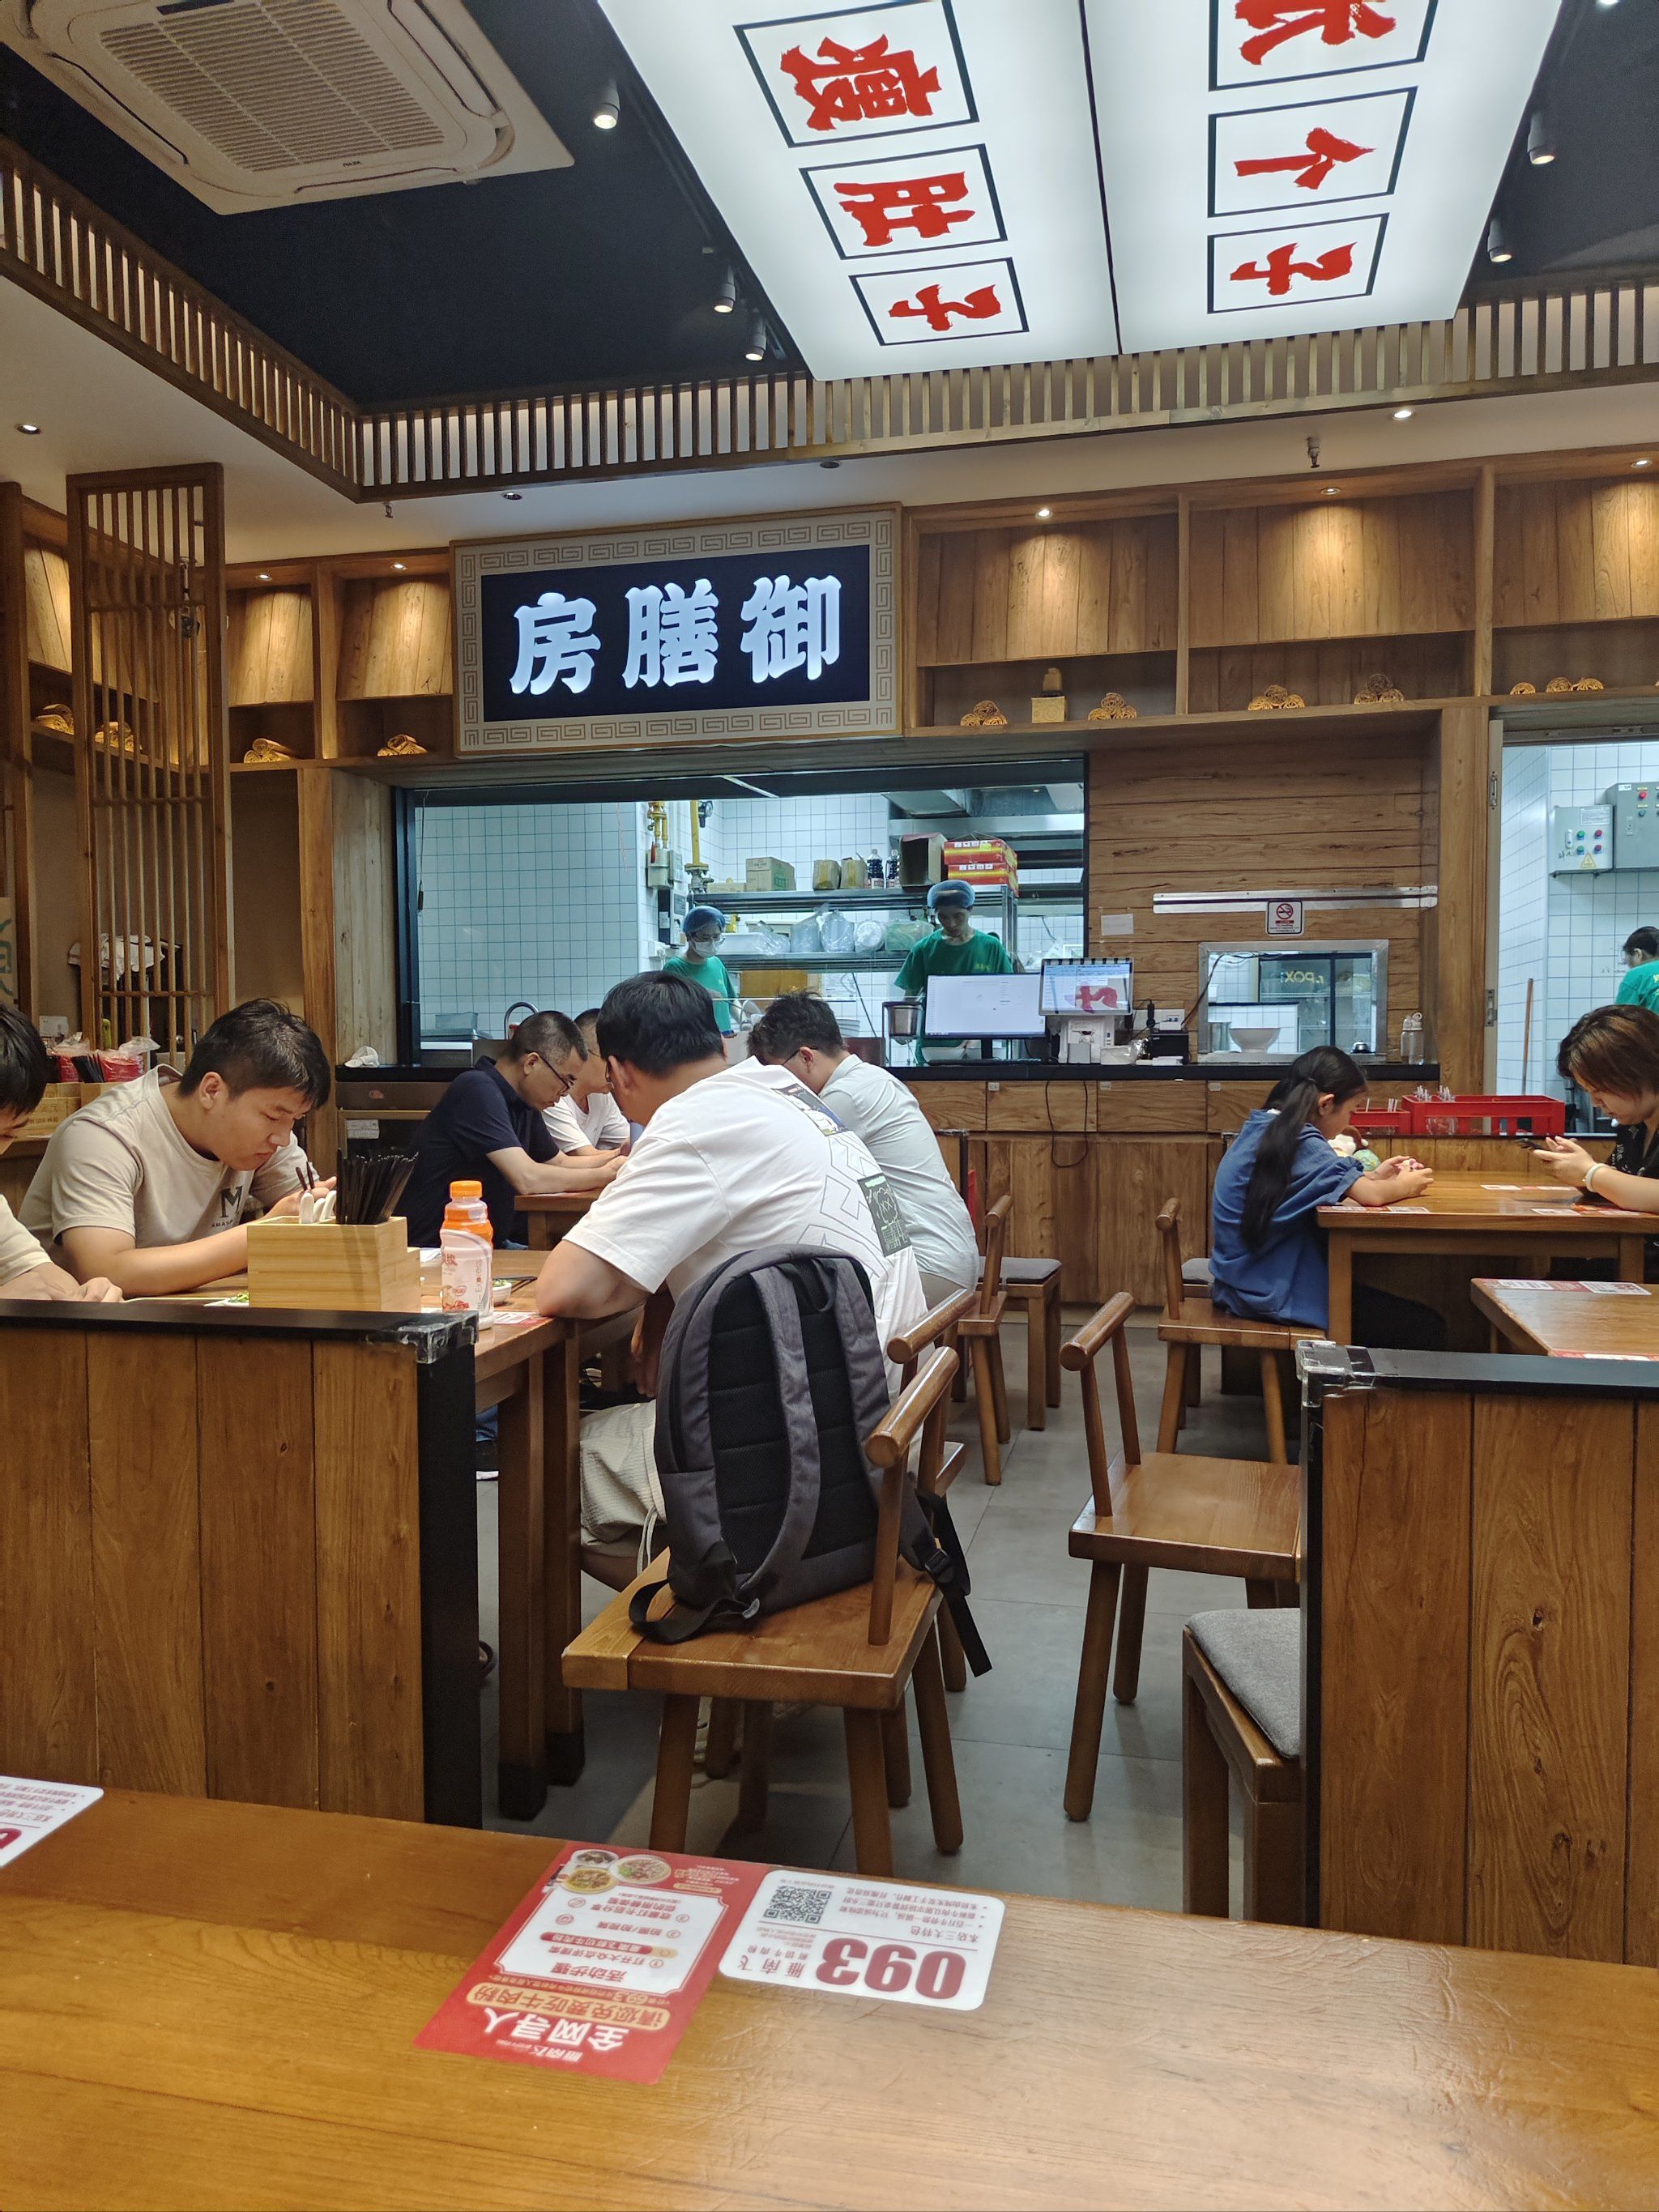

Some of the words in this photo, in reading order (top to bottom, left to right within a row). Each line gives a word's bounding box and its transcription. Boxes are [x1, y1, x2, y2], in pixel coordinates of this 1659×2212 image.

[779, 32, 1003, 333] 瘦肚子
[910, 1924, 979, 1944] 本店三大特色
[551, 1961, 628, 1983] 活动步骤
[737, 1954, 807, 1979] 雁南飞
[815, 1937, 966, 2000] 093
[474, 1985, 665, 2028] 请您免费吃牛肉粉
[484, 2008, 629, 2052] 全网寻人
